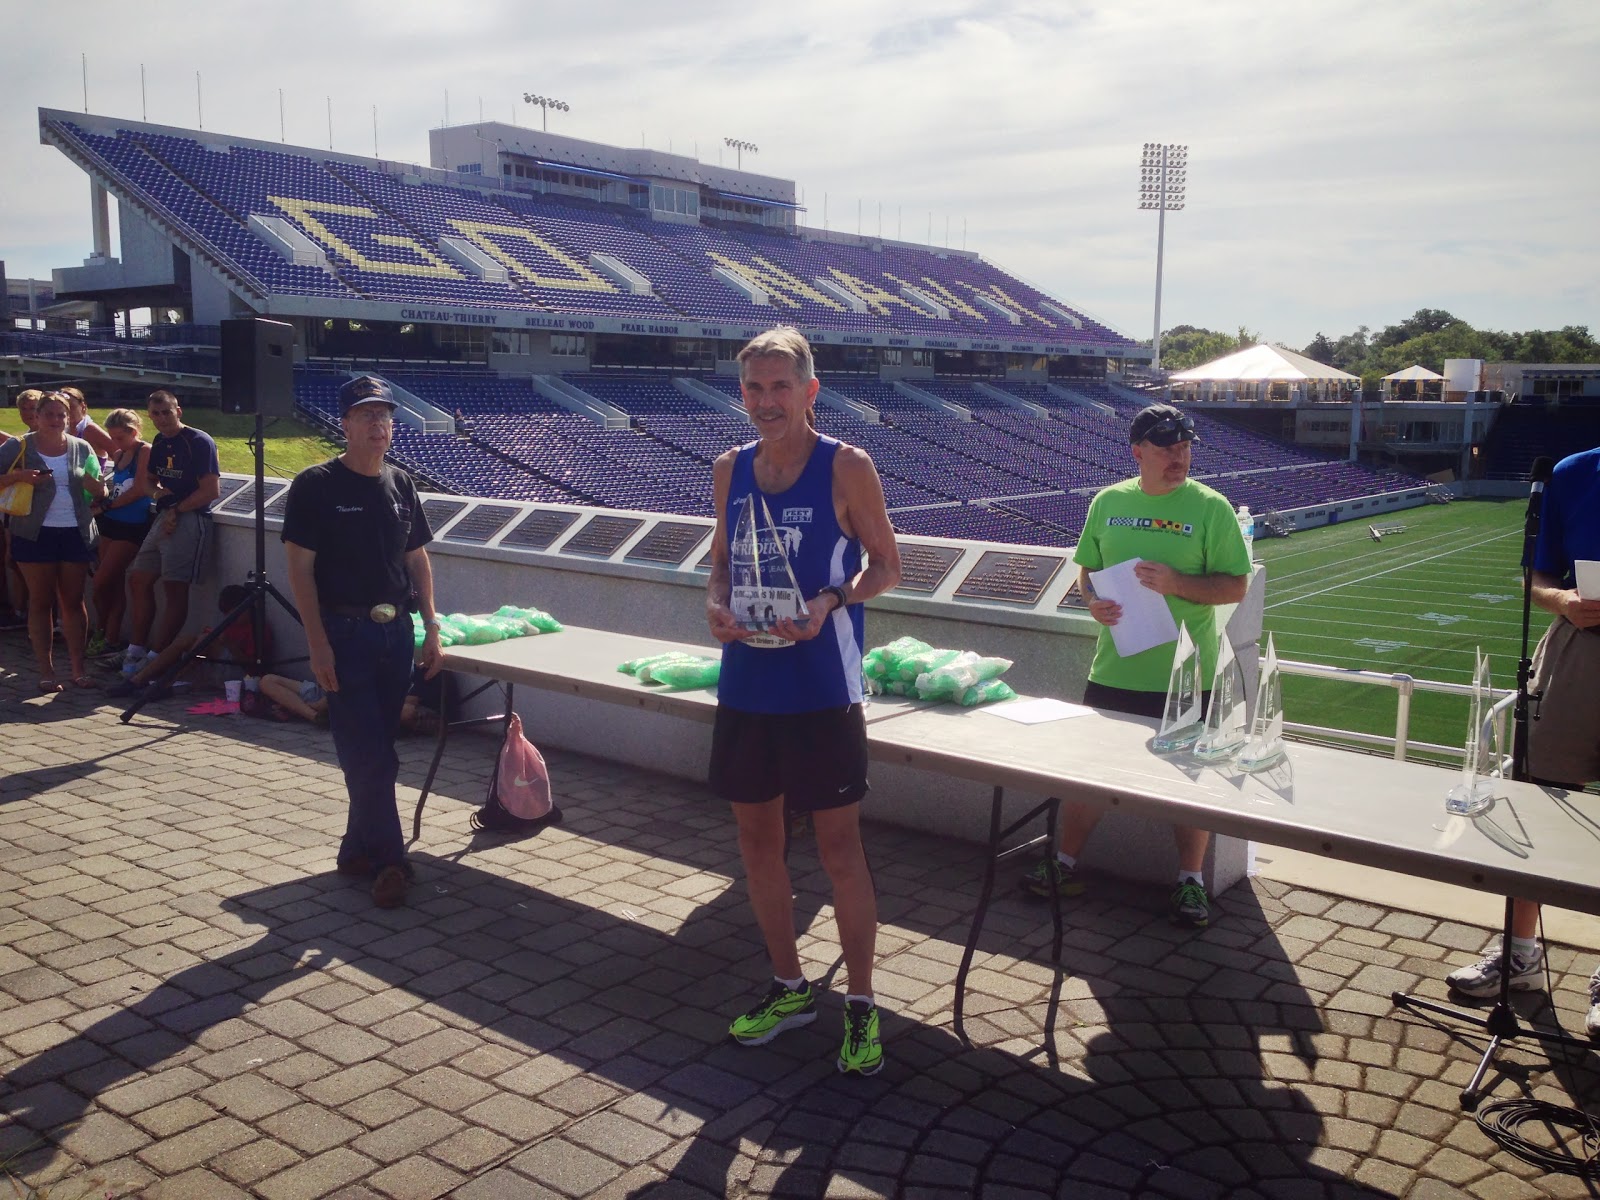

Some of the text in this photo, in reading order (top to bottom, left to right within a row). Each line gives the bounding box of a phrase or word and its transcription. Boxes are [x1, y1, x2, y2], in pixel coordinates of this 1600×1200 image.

[266, 195, 1057, 328] GO NAVY
[400, 308, 497, 325] CHATEAU-THIERRY
[525, 317, 594, 330] BELLEAU WOOD
[621, 323, 679, 334] PEARL HARBOR
[702, 328, 722, 337] WAKE
